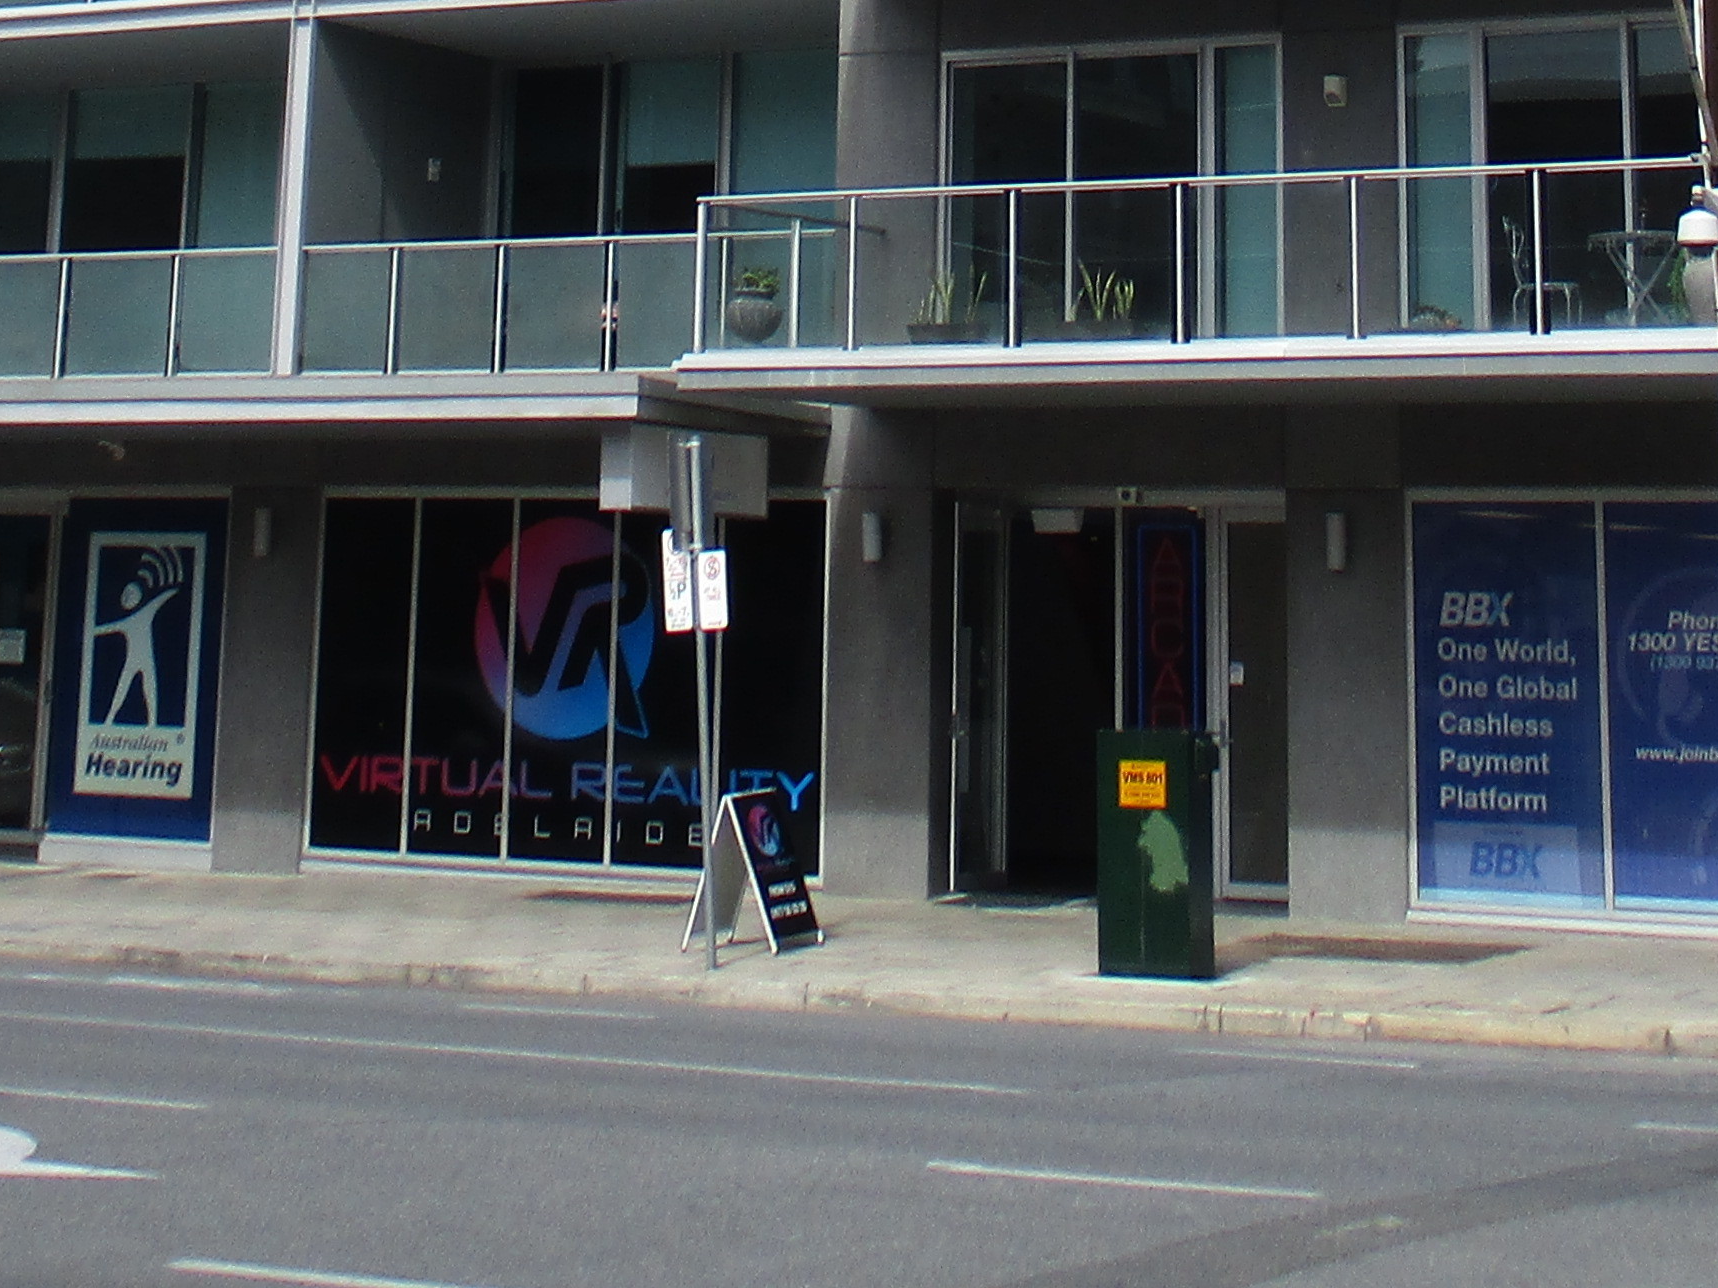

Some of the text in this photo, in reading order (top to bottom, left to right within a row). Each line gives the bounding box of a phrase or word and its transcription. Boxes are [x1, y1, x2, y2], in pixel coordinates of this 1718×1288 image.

[1439, 591, 1514, 627] BBX
[1437, 636, 1576, 667] One World,
[1628, 631, 1676, 653] 1300
[1438, 674, 1578, 701] One Global
[1438, 711, 1554, 737] Cashless
[89, 733, 169, 753] Australian
[85, 752, 183, 787] Hearing
[1438, 746, 1551, 777] Payment
[320, 754, 815, 811] VIRTUAL REALITY
[1439, 784, 1548, 812] Platform
[413, 808, 705, 848] ADELAIDE
[1468, 840, 1543, 878] BBX
